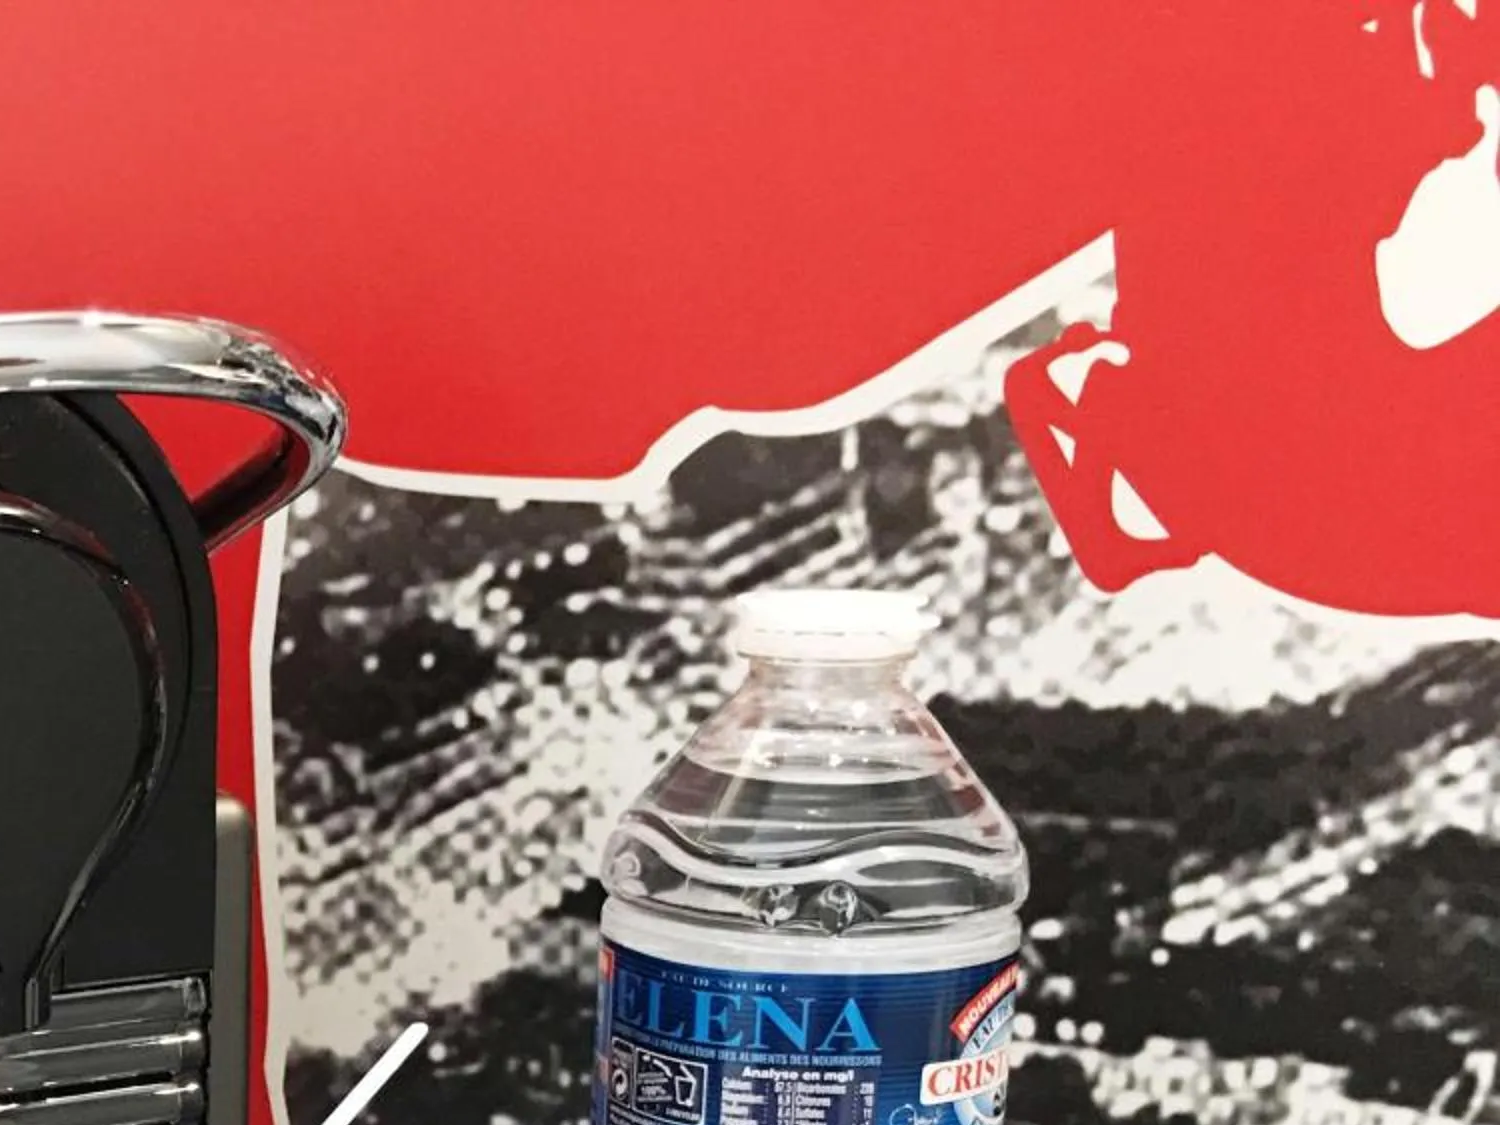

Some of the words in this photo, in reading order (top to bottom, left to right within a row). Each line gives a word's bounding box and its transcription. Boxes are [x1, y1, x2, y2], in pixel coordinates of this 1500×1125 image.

[615, 968, 883, 1052] ELENA
[742, 1066, 800, 1082] Analyse
[802, 1070, 821, 1081] en
[823, 1069, 855, 1083] mg/l
